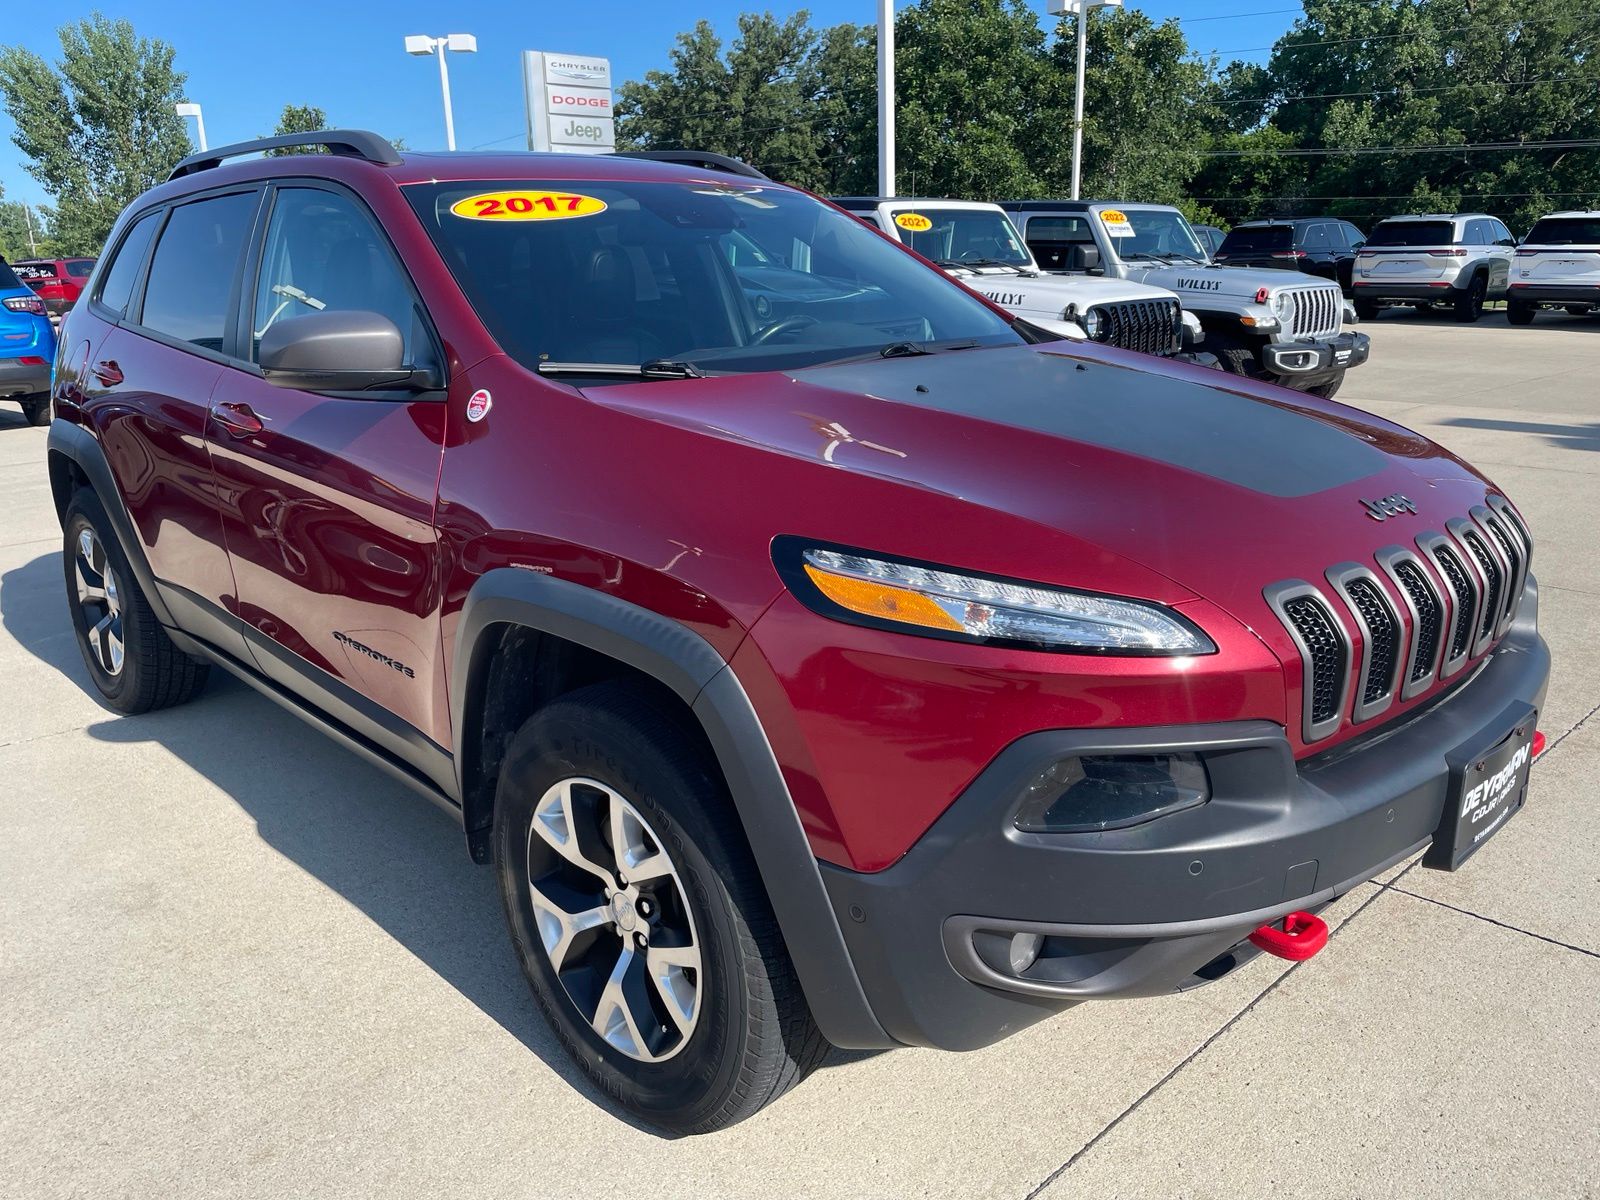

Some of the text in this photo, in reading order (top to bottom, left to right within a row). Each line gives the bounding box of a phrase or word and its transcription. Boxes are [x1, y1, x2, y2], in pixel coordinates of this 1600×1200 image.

[551, 62, 606, 72] CHRYSLER
[552, 95, 609, 108] DODGE
[564, 120, 602, 141] Jeep
[474, 196, 584, 217] 2017
[900, 217, 927, 227] 2021
[1104, 213, 1125, 221] 2022
[1177, 278, 1222, 291] WILLYS
[980, 291, 1026, 305] ILLYS
[1358, 493, 1418, 523] Jeep
[332, 631, 416, 679] CHEROKEE
